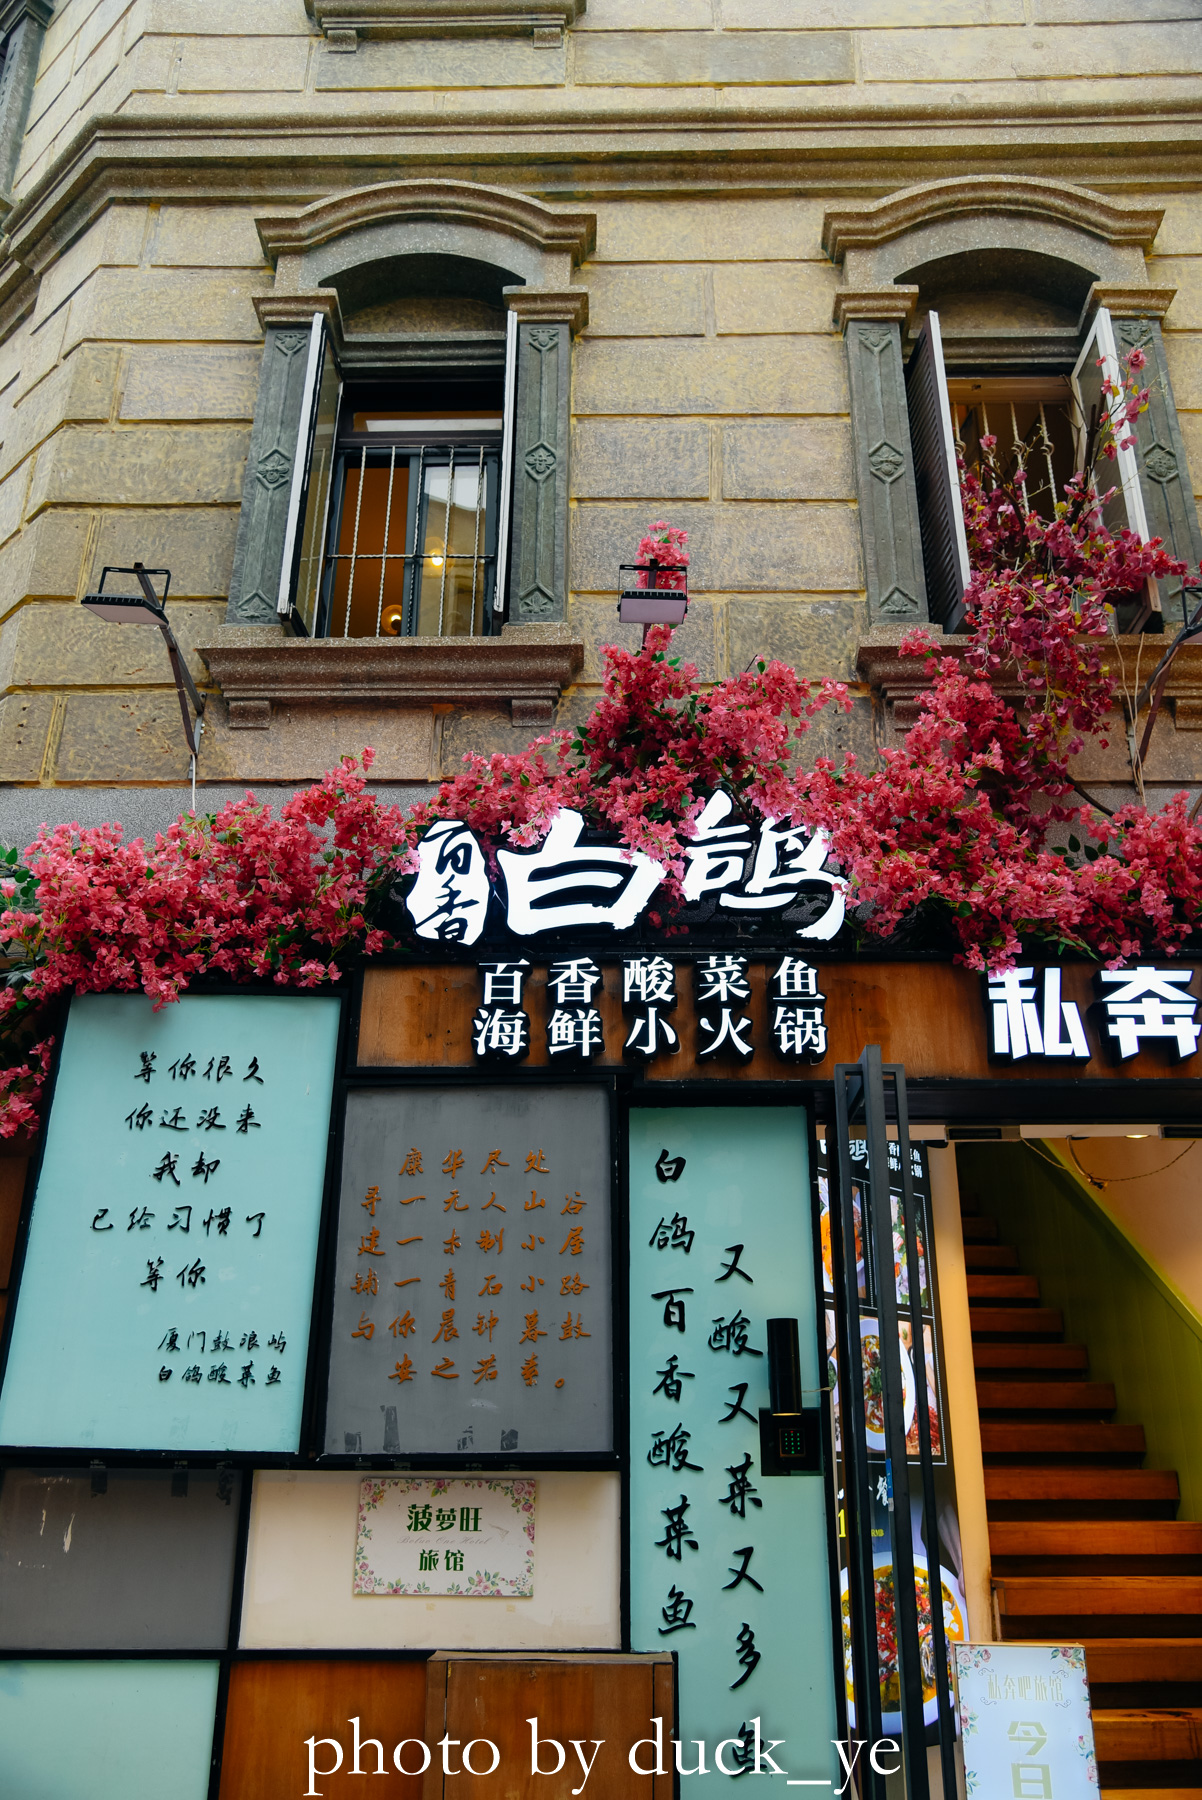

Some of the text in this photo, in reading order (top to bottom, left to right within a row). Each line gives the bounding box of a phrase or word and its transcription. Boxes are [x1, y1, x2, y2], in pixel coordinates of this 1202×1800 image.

[497, 789, 847, 941] 白鸽
[478, 956, 826, 1005] 百香酸菜鱼
[987, 966, 1202, 1060] 私奔
[473, 1008, 828, 1057] 海鲜小火锅
[133, 1050, 265, 1085] 等你很久
[124, 1102, 262, 1134] 你还没来
[152, 1151, 221, 1186] 我却
[90, 1205, 267, 1238] 已经习惯了
[357, 1226, 586, 1256] 建一木制小屋
[139, 1256, 207, 1291] 等你
[350, 1267, 591, 1301] 铺一青石小路
[156, 1326, 288, 1354] 厦门鼓浪屿
[351, 1308, 592, 1345] 与你晨钟暮鼓
[158, 1359, 283, 1389] 白鸽酸菜鱼
[646, 1148, 704, 1637] 白鸽百香酸菜鱼
[406, 1503, 483, 1532] 菠萝旺
[707, 1243, 768, 1778] 又酸又菜又多鱼
[418, 1549, 465, 1572] 旅馆
[987, 1674, 1064, 1701] 私奔吧旅馆
[1007, 1720, 1053, 1800] 今日
